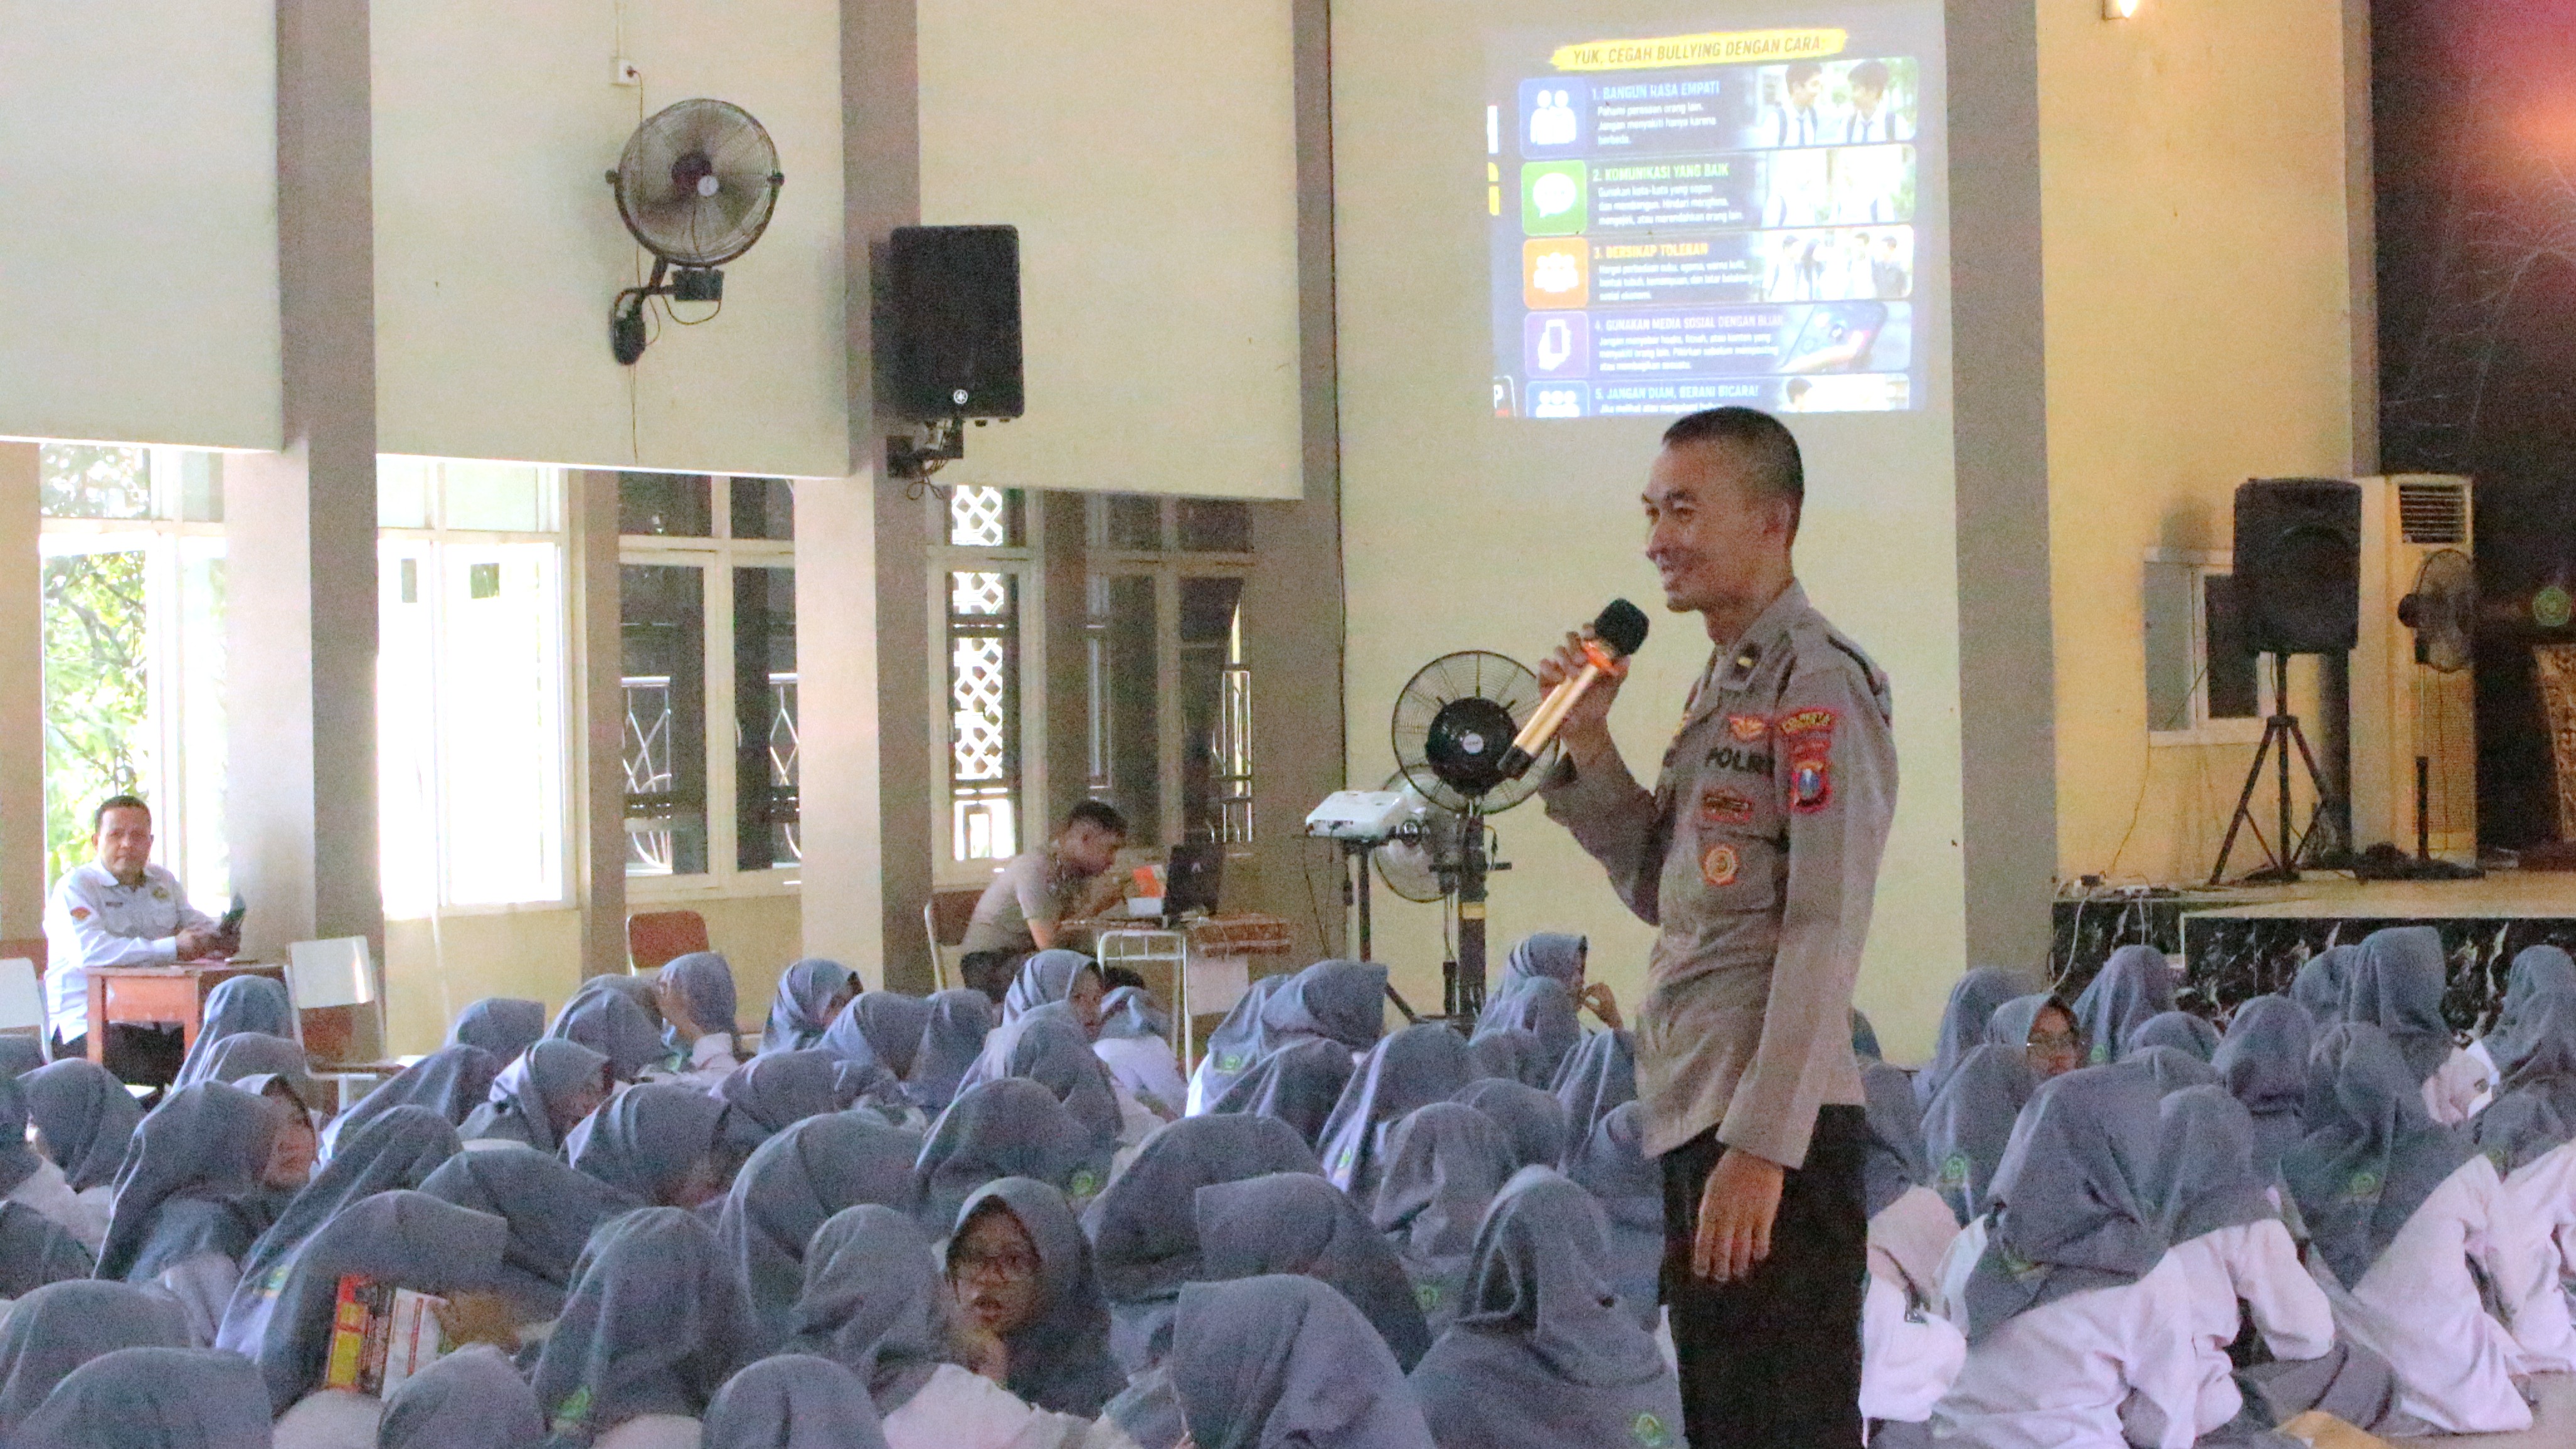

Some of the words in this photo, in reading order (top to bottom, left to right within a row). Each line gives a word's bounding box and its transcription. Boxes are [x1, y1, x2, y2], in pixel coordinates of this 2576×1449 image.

[1573, 50, 1603, 65] YUK,
[1608, 47, 1652, 63] CEGAH
[1656, 41, 1721, 61] BULLYING
[1725, 38, 1780, 56] DENGAN
[1603, 85, 1647, 100] BANGUN
[1681, 80, 1719, 96] EMPATI
[1593, 169, 1603, 182] 2.
[1605, 166, 1671, 182] KOMUNIKASI
[1673, 164, 1702, 178] YANG
[1704, 163, 1729, 177] BAIK
[1606, 317, 1650, 331] GUNAKAN
[1651, 317, 1682, 329] MEDIA
[1683, 316, 1716, 329] SOSIAL
[1718, 315, 1757, 328] DENGAN
[1606, 387, 1646, 400] JANGAN
[1648, 386, 1677, 400] DIAM,
[1679, 385, 1715, 398] BERANI
[1717, 384, 1759, 398] BICARA!
